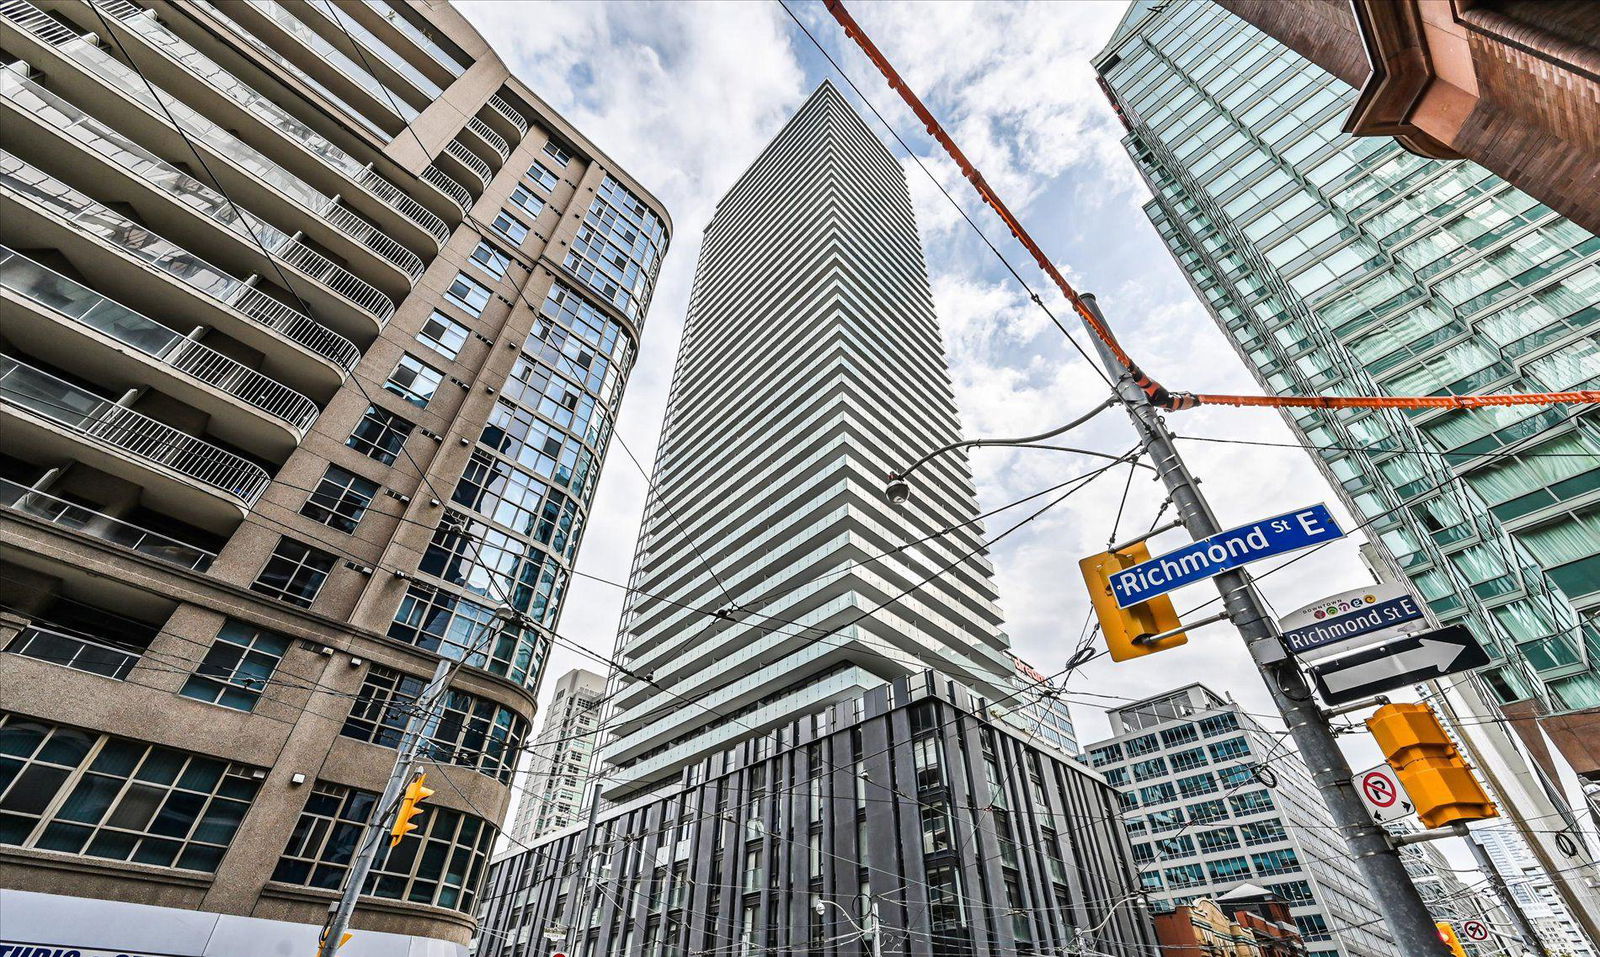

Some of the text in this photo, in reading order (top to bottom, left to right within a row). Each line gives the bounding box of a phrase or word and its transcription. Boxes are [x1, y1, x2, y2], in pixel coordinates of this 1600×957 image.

[1120, 511, 1326, 597] Richmond St E
[1289, 599, 1417, 649] Richmond St E
[1302, 599, 1342, 615] DOWNTOWN
